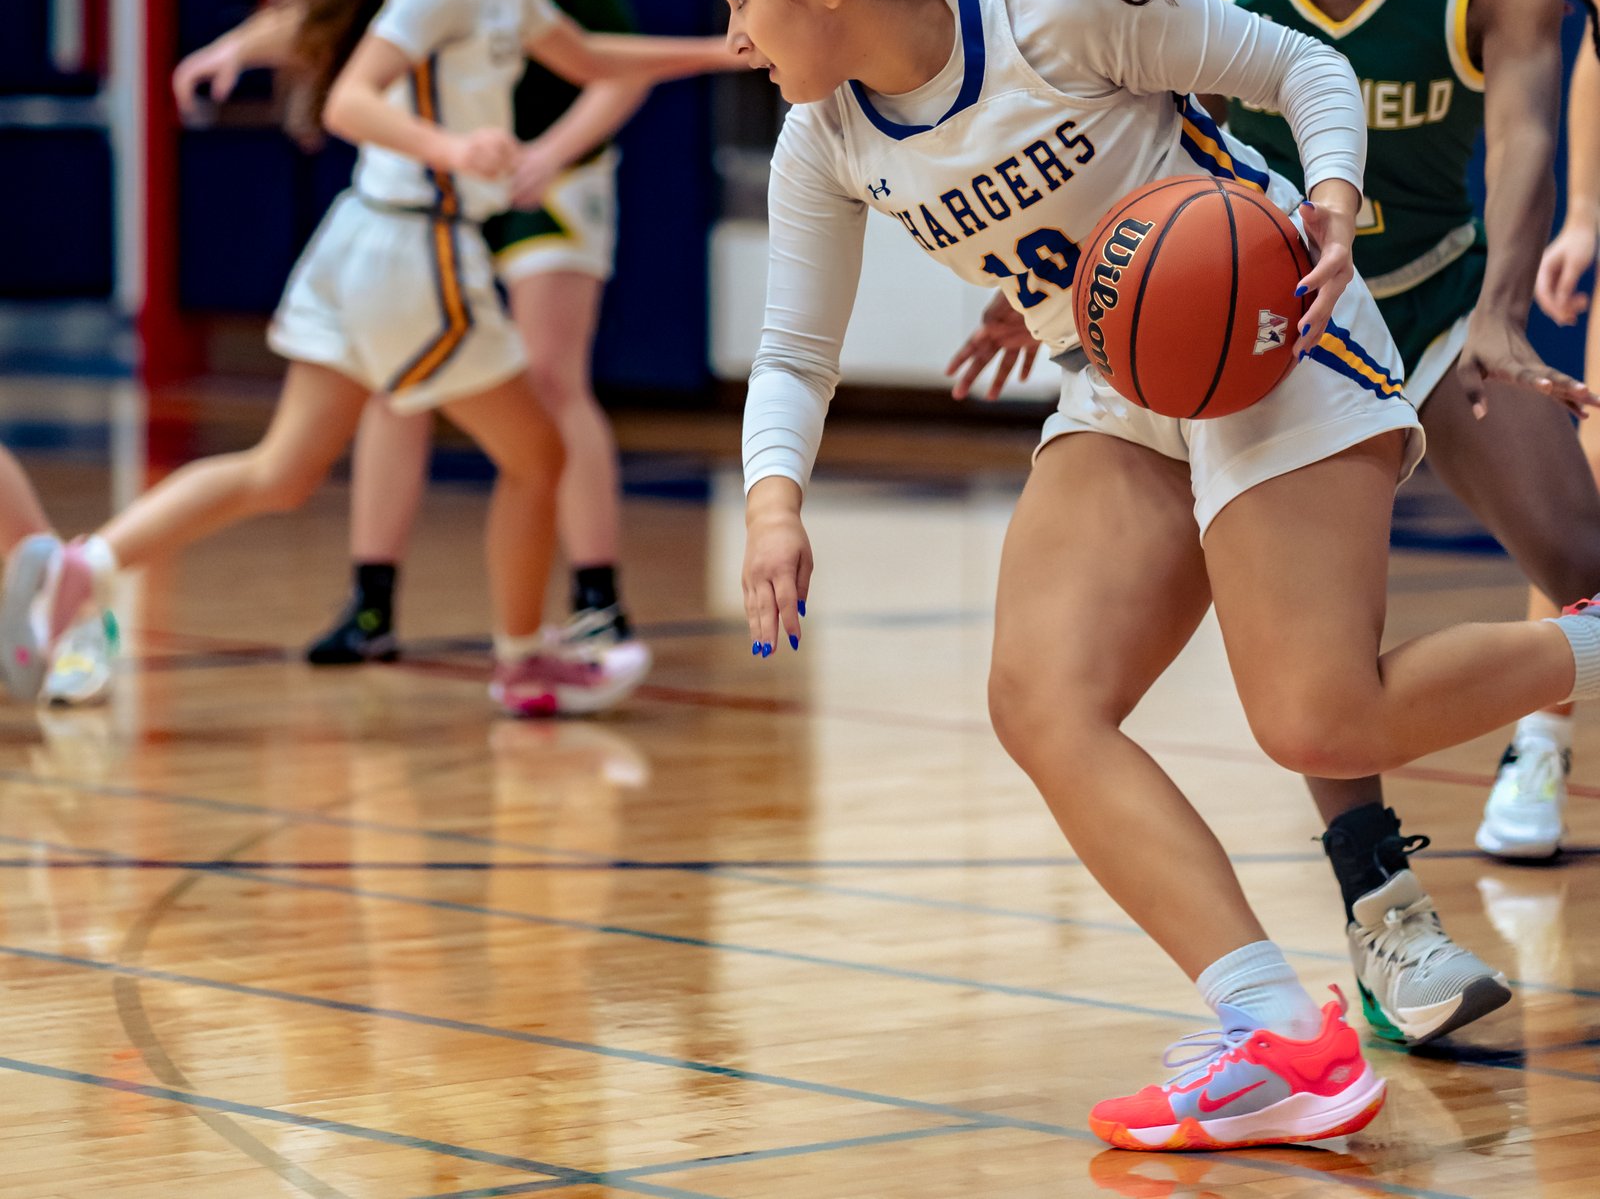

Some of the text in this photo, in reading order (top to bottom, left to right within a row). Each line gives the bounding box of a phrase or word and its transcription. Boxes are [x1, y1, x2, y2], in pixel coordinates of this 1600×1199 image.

[1359, 78, 1454, 130] IELD
[889, 120, 1096, 252] HARGERS
[980, 226, 1082, 310] 10
[1087, 218, 1156, 376] Wilson
